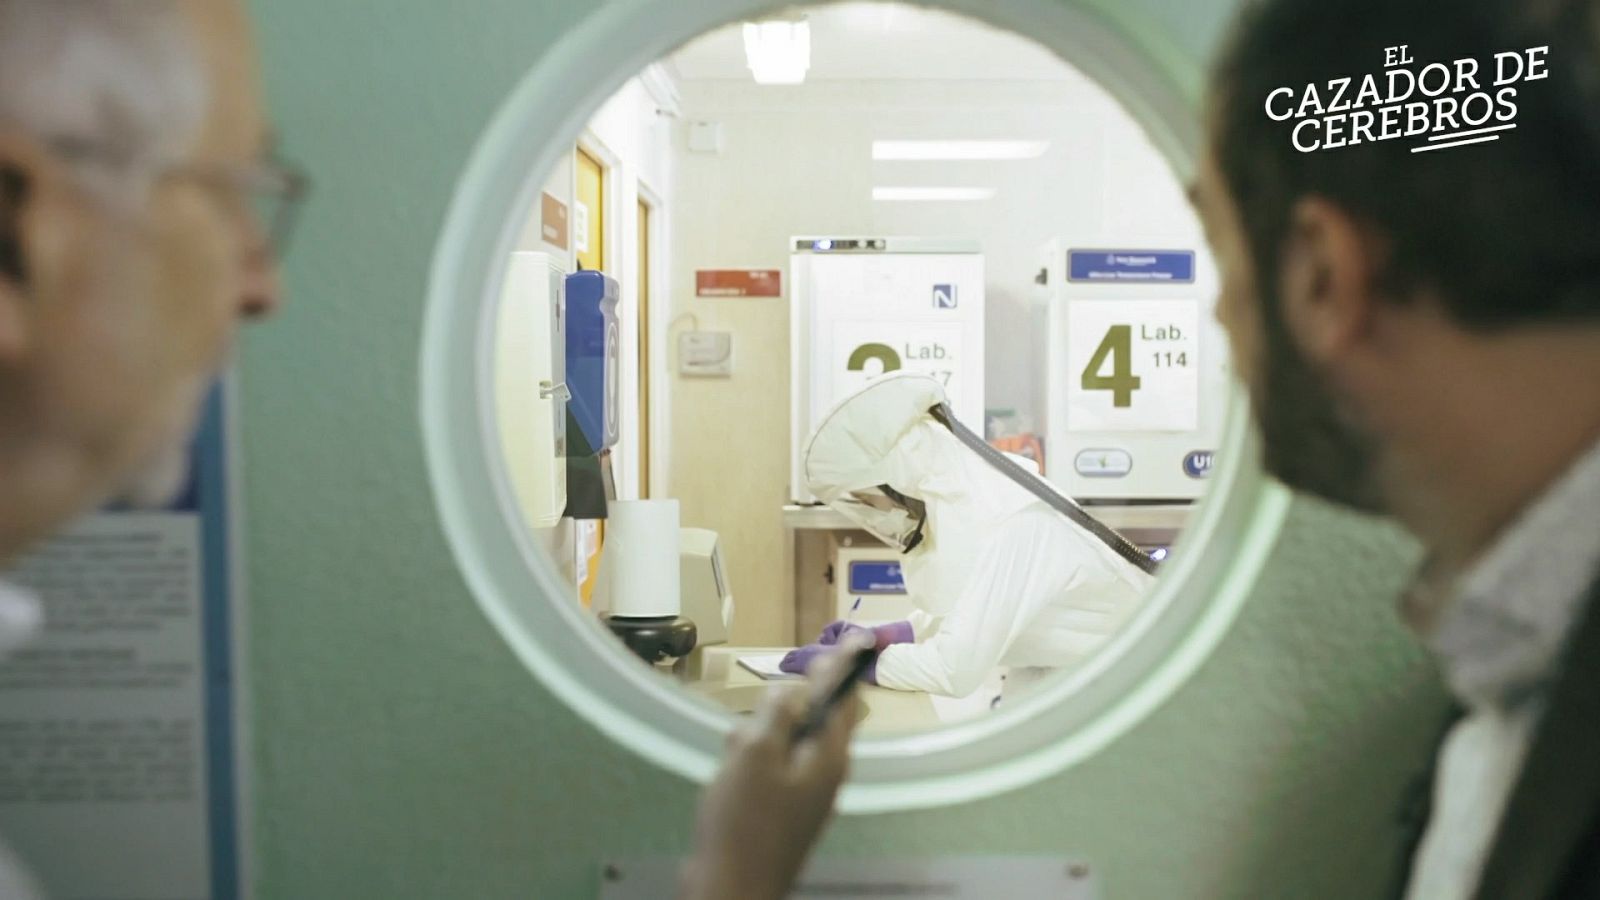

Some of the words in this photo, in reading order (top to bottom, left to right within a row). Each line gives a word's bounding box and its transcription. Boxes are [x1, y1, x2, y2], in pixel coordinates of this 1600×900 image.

[1141, 324, 1188, 341] Lab.
[905, 342, 953, 361] Lab.
[1153, 352, 1188, 368] 114
[1081, 325, 1141, 408] 4
